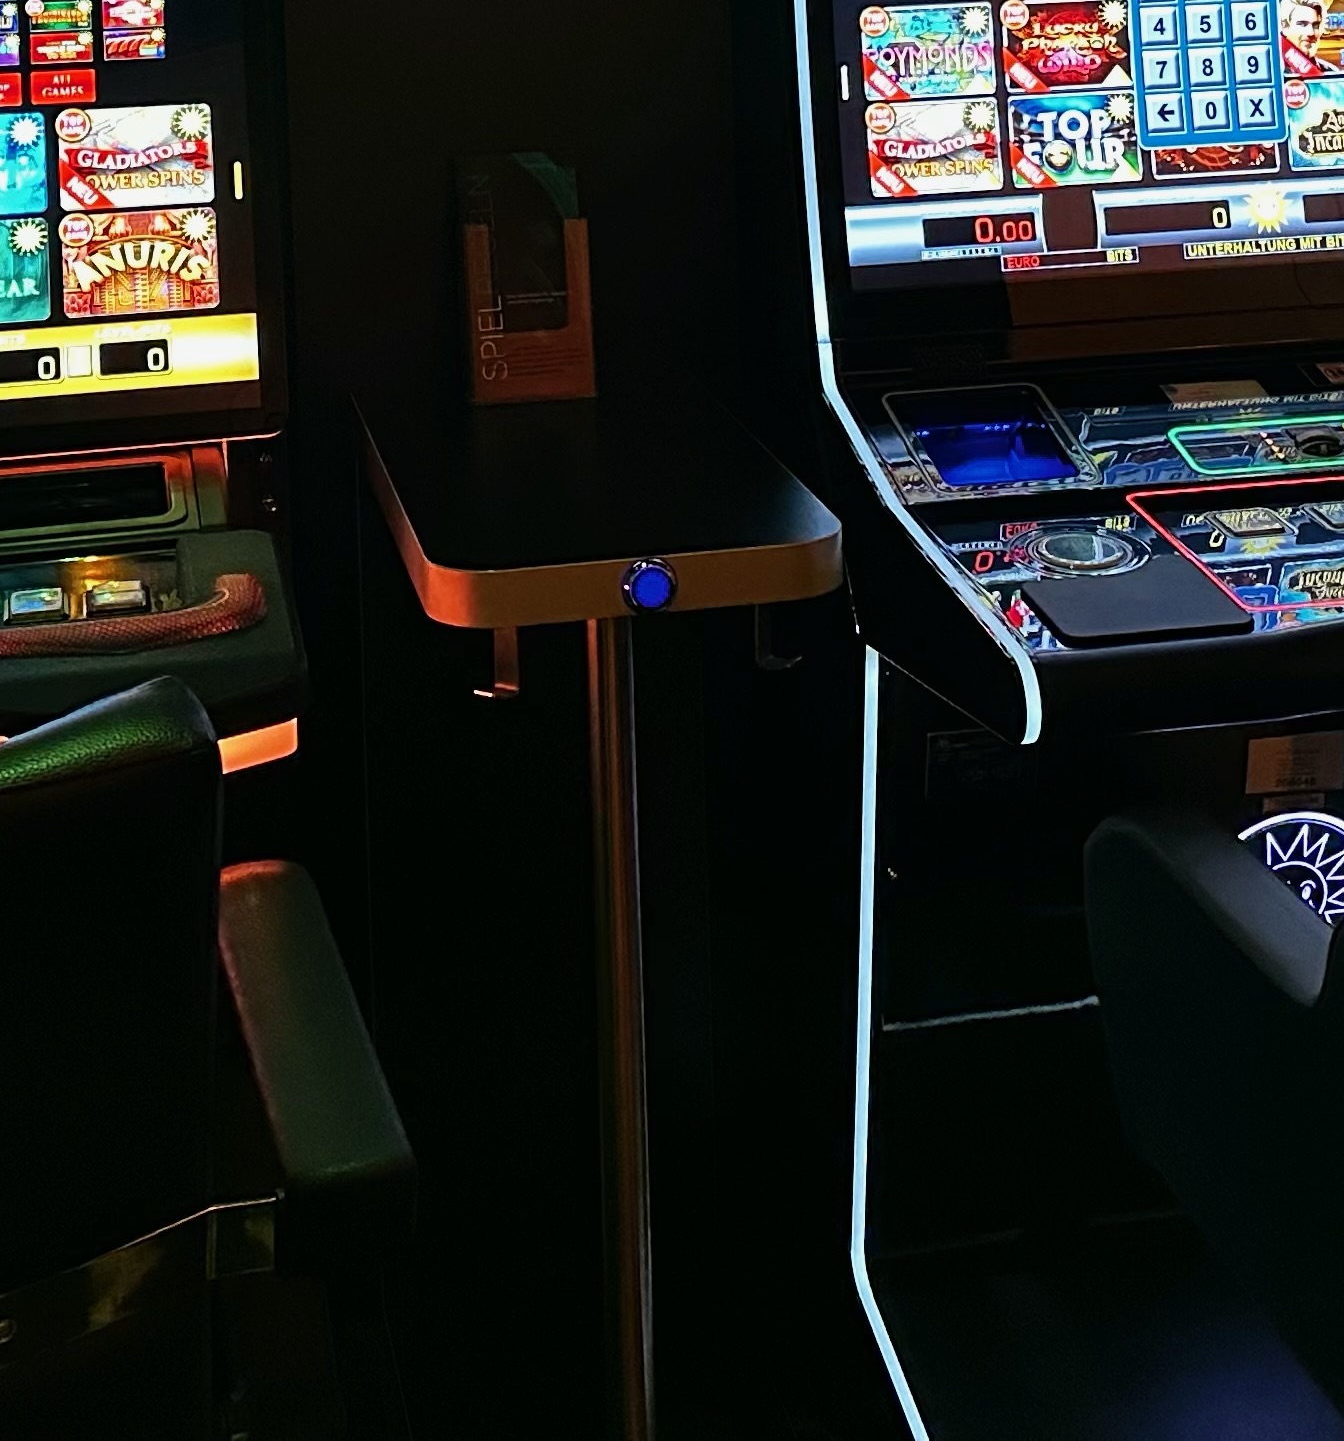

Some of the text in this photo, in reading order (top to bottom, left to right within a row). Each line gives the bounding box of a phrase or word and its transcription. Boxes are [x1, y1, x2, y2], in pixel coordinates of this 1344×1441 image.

[1153, 17, 1166, 35] 4
[1199, 15, 1211, 33] 5
[1245, 13, 1257, 31] 6
[1156, 61, 1168, 79] 7
[1202, 58, 1214, 76] 8
[1247, 56, 1259, 74] 9
[41, 86, 84, 97] GAMES
[1205, 102, 1217, 120] 0
[1249, 99, 1265, 117] X
[1037, 109, 1112, 143] TOP
[77, 141, 198, 170] GLADIATORS
[892, 159, 994, 178] OWER SPINS
[84, 169, 206, 192] OWER SPINS
[65, 176, 99, 206] NEU
[1212, 207, 1227, 228] 0
[975, 217, 1033, 244] 0.00
[1106, 249, 1133, 262] BITS
[1187, 238, 1297, 258] UNTERHALTUNG
[1299, 236, 1323, 250] MIT
[72, 240, 211, 293] ANURIS
[1006, 256, 1040, 269] EURO
[37, 356, 56, 380] 0
[147, 347, 165, 371] 0
